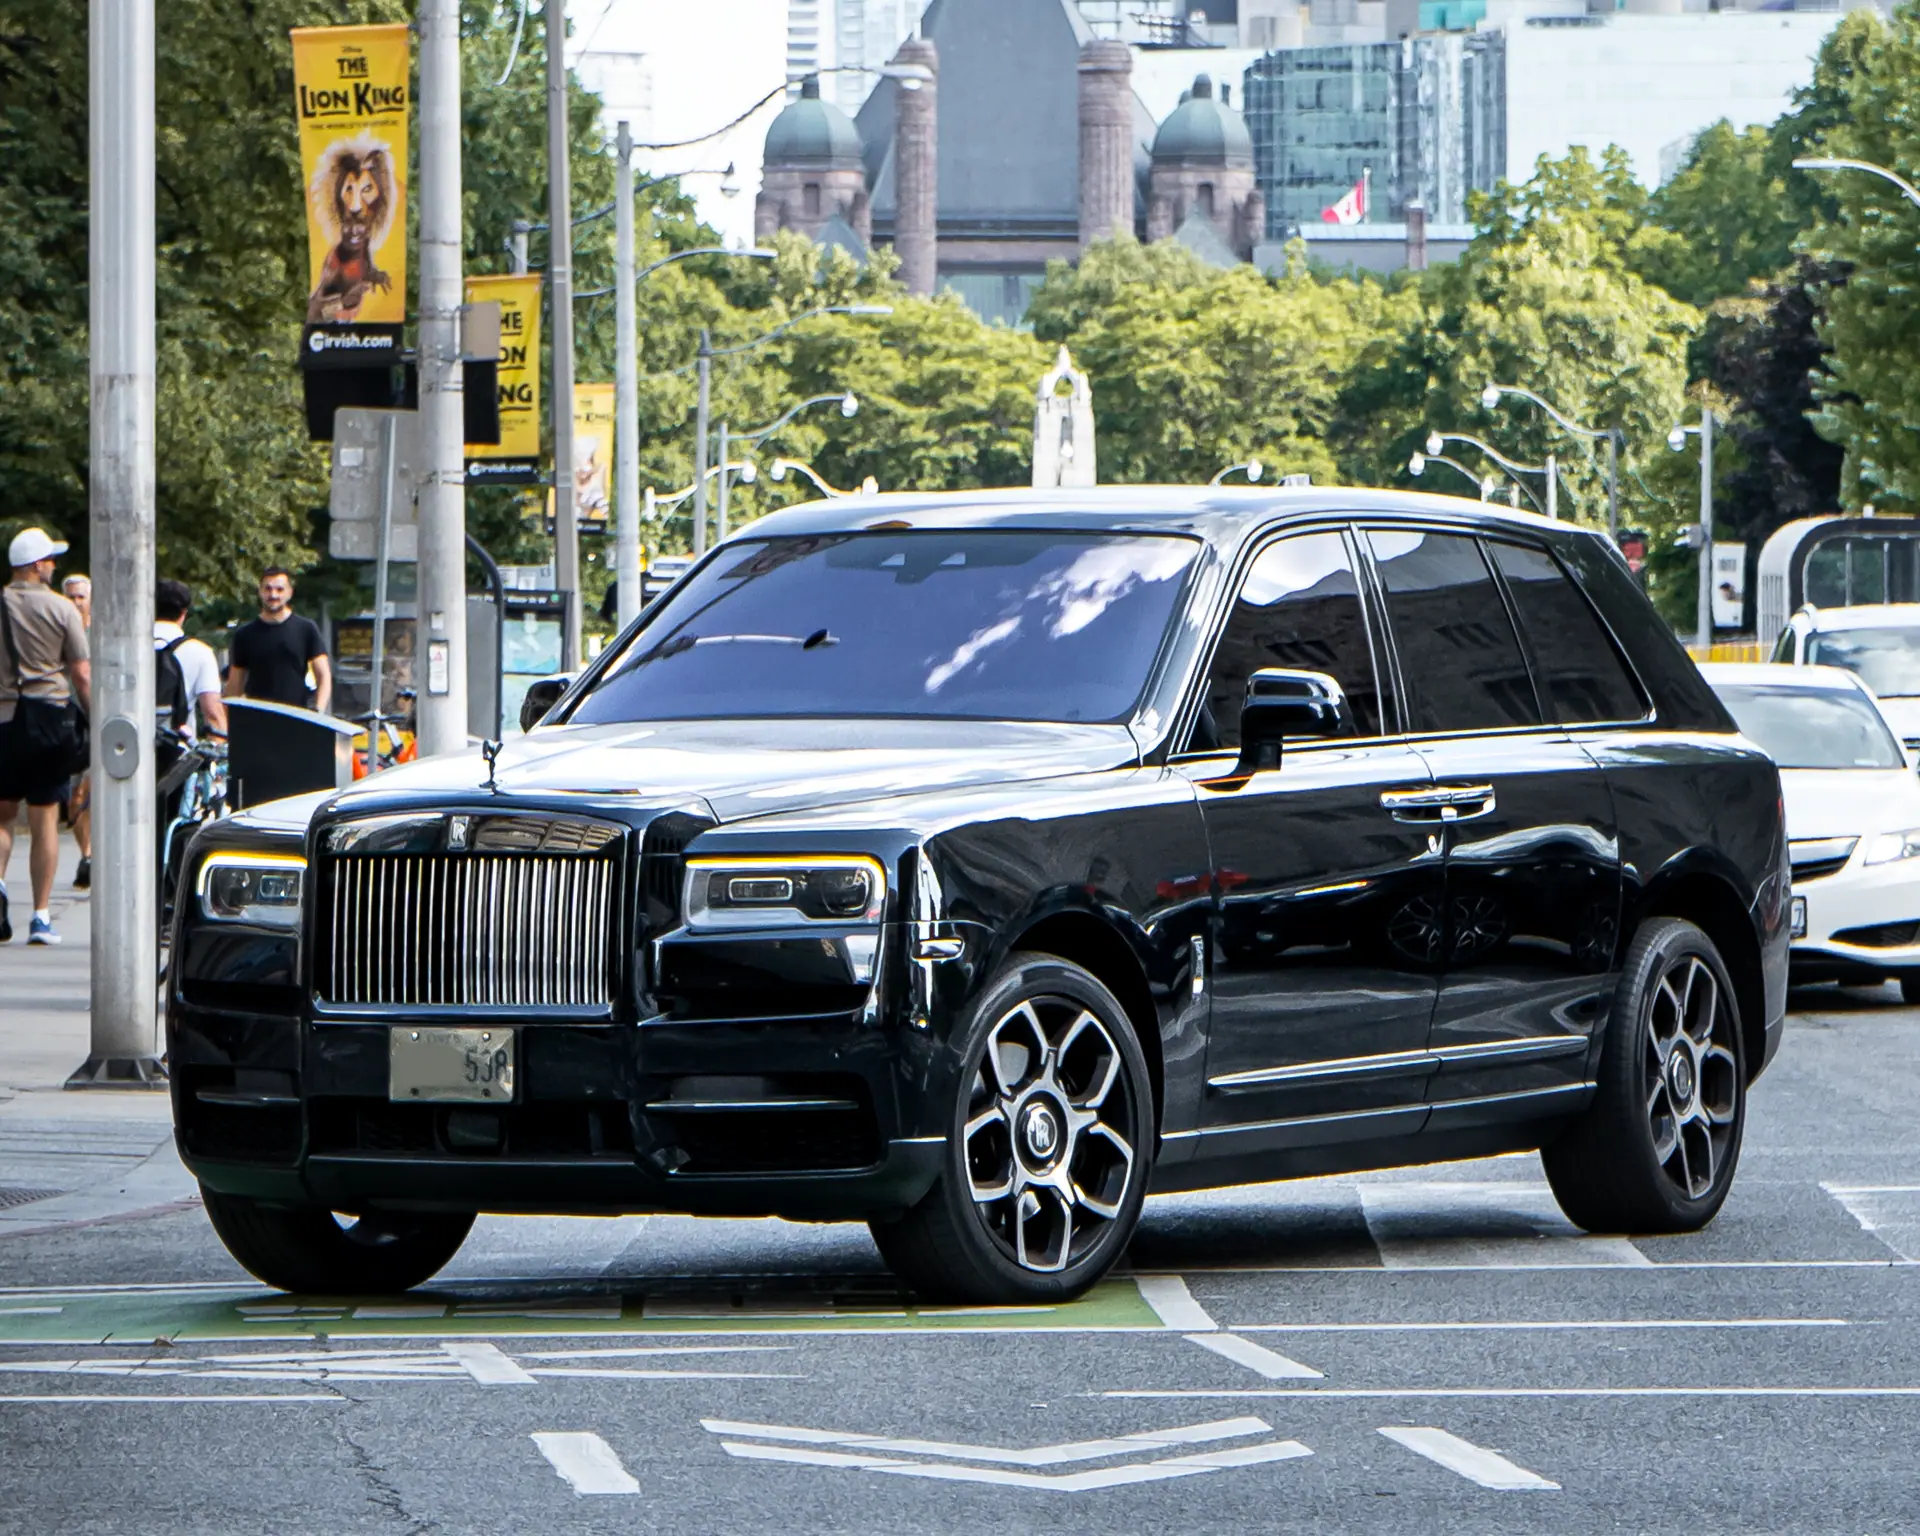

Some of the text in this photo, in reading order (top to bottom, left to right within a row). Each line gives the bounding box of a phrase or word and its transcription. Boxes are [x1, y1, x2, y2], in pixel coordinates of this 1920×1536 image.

[336, 57, 369, 74] THE
[500, 310, 523, 330] HE
[498, 344, 527, 364] ON
[498, 383, 533, 403] NG
